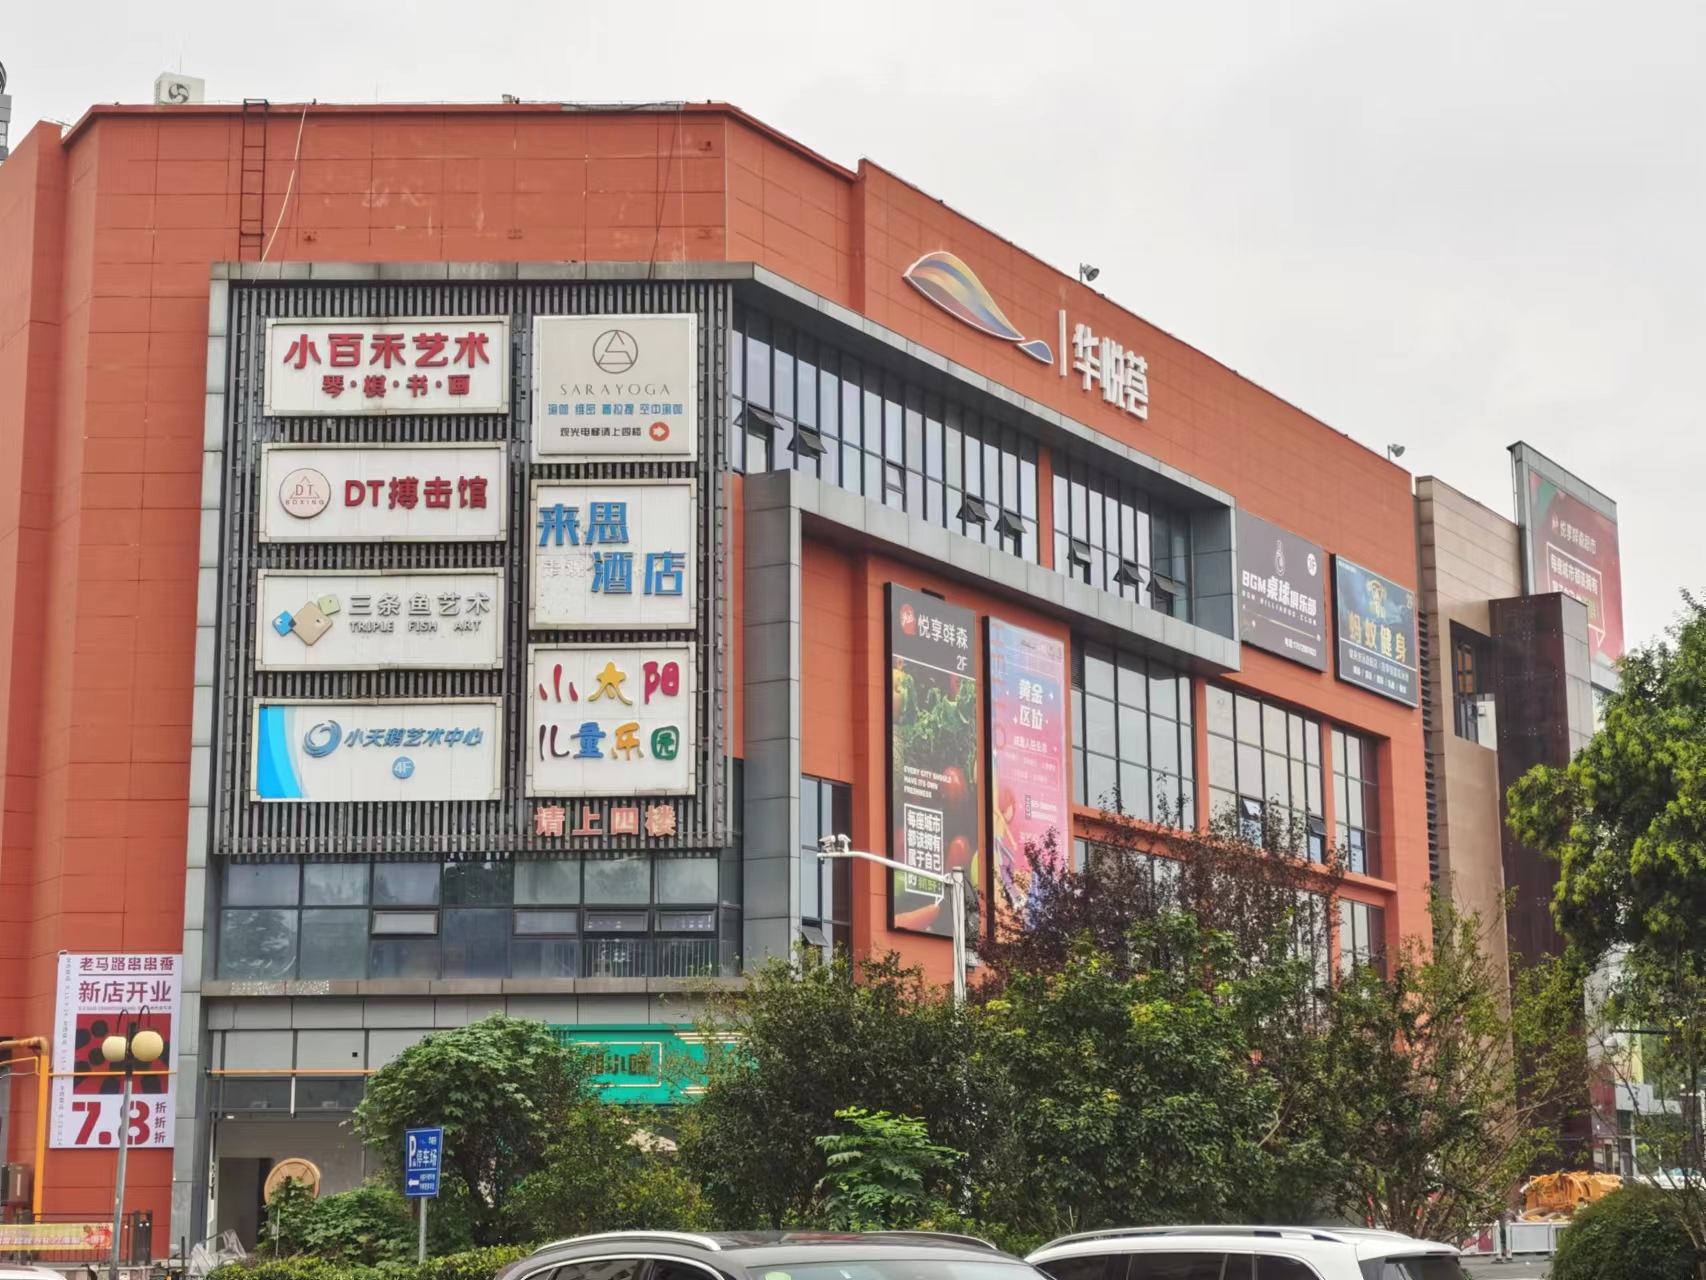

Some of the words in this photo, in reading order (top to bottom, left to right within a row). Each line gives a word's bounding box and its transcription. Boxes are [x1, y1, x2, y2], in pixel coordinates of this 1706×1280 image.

[283, 332, 490, 369] 小百禾艺术
[537, 502, 629, 546] 来思
[591, 550, 686, 596] 酒店
[349, 593, 491, 616] 三条鱼艺术
[349, 621, 395, 633] TRIPLE
[408, 621, 438, 633] FISH
[453, 620, 482, 632] ART
[956, 655, 967, 671] 2F
[539, 661, 680, 706] 小太阳
[1019, 679, 1043, 704] 黄金
[1019, 705, 1043, 730] 区位
[344, 727, 484, 748] 小天鹅艺术中心
[539, 721, 680, 761] 儿童乐园
[394, 761, 411, 774] 4F
[534, 805, 676, 837] 请上四楼
[907, 809, 941, 833] 每座城市
[907, 828, 941, 853] 都该拥有
[908, 848, 941, 871] 属于自己
[79, 981, 172, 1003] 新店开业
